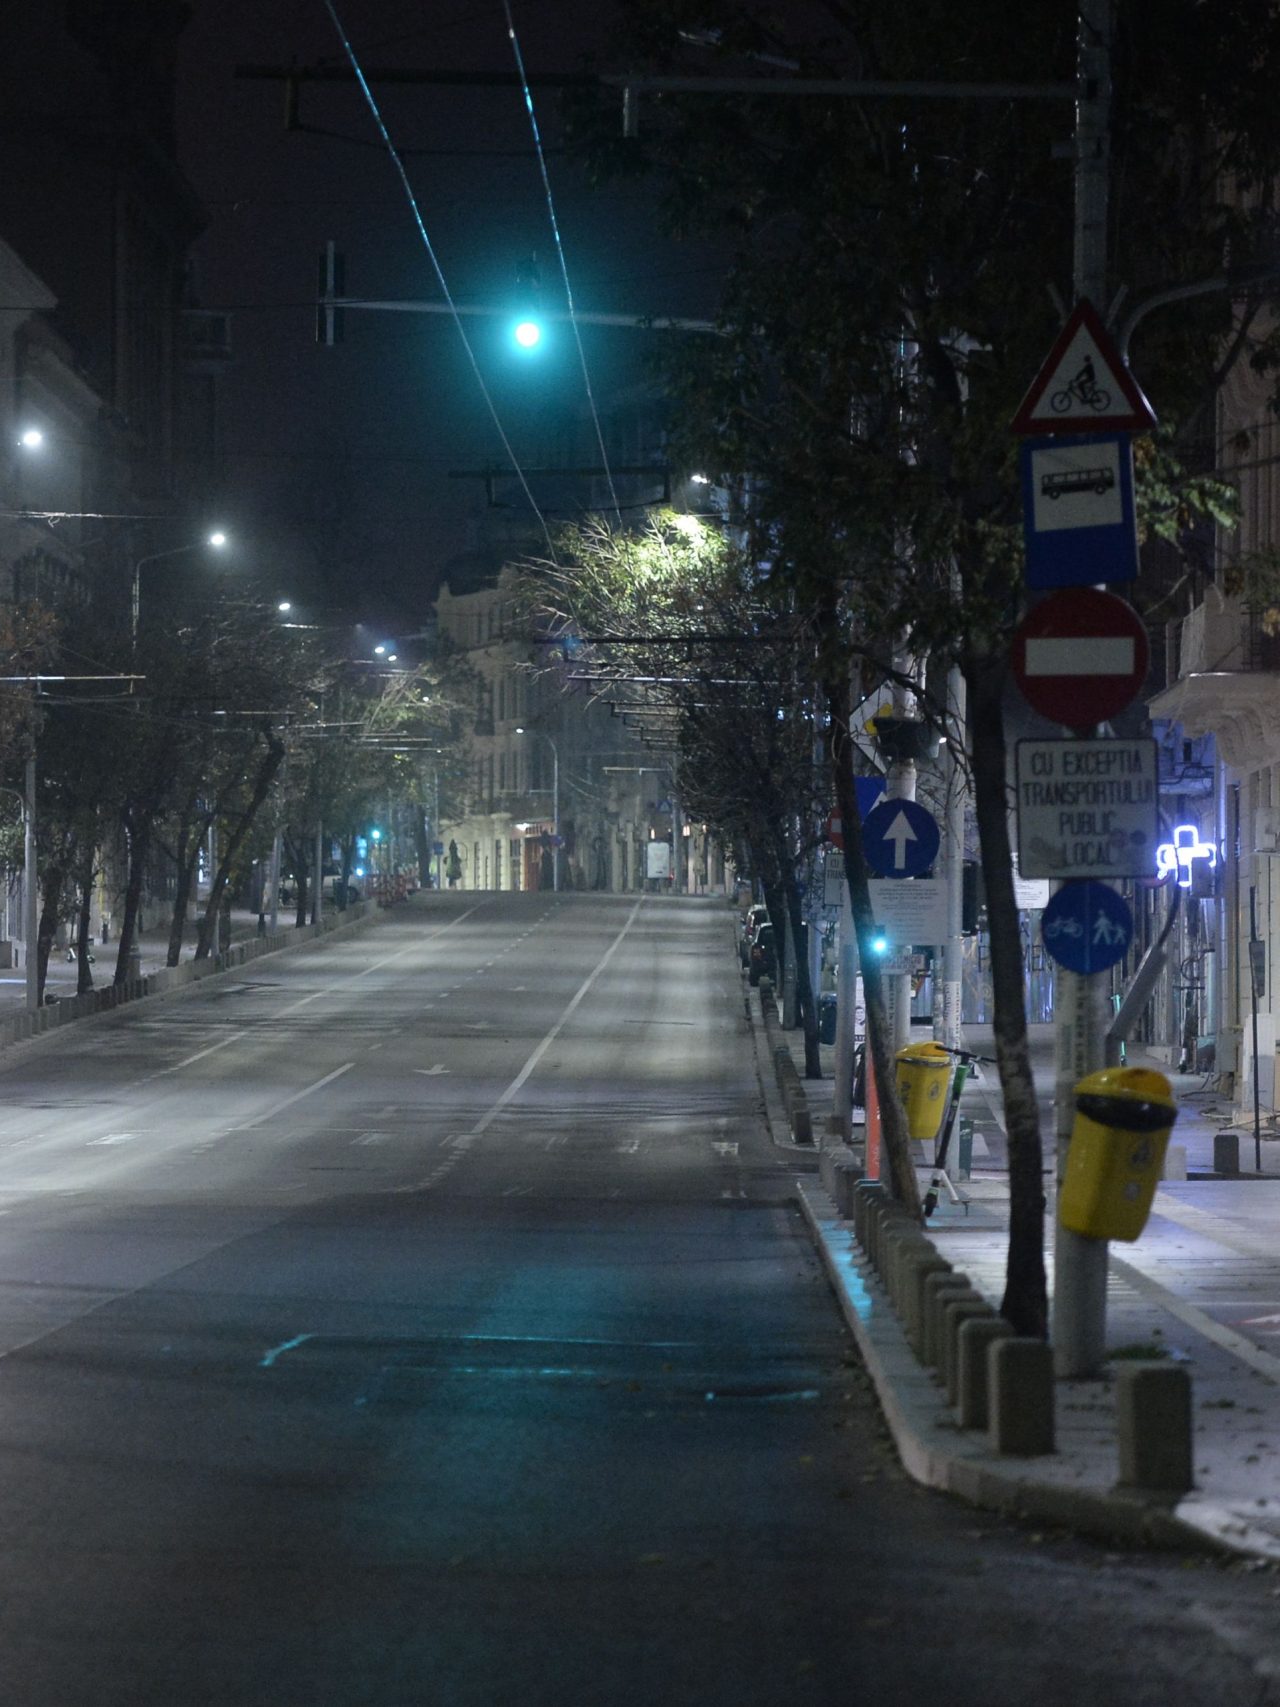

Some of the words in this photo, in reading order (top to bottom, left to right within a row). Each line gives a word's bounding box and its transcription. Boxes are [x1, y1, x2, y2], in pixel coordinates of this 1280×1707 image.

[1031, 751, 1053, 775] CU
[1063, 749, 1143, 775] EXCEPTIA
[1022, 779, 1154, 806] TRANSPORTULUI
[1058, 809, 1117, 836] PUBLIC
[1061, 841, 1115, 868] LOCAL
